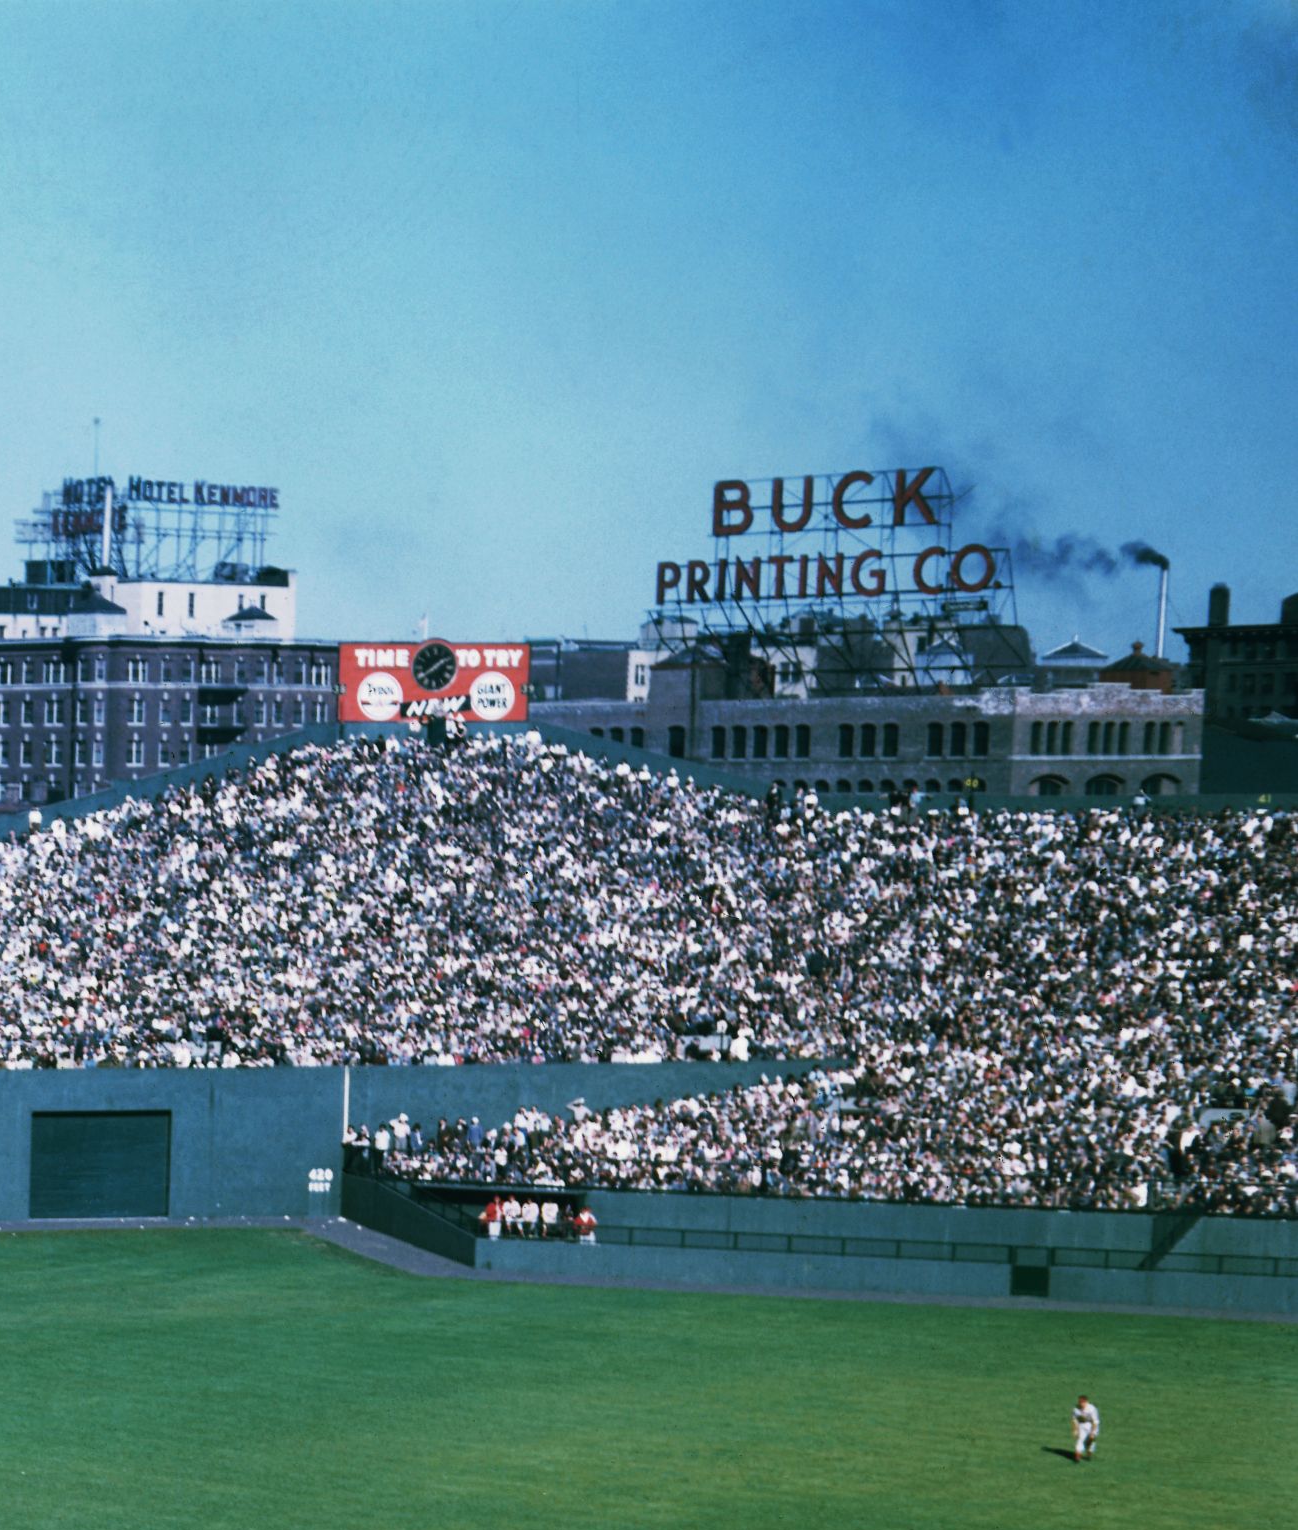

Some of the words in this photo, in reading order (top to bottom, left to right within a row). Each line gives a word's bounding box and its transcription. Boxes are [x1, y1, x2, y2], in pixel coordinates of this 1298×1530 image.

[63, 475, 115, 504] HOTE
[128, 474, 190, 504] HOTEL
[193, 480, 280, 509] KENMORE
[712, 466, 941, 537] BUCK
[656, 549, 887, 605] PRINTING
[913, 543, 1003, 595] CO.
[355, 649, 409, 667] TIME
[456, 649, 481, 667] TO
[483, 649, 523, 667] TRY
[477, 683, 506, 695] GIANT
[477, 698, 508, 709] POWER
[308, 1168, 333, 1181] 420
